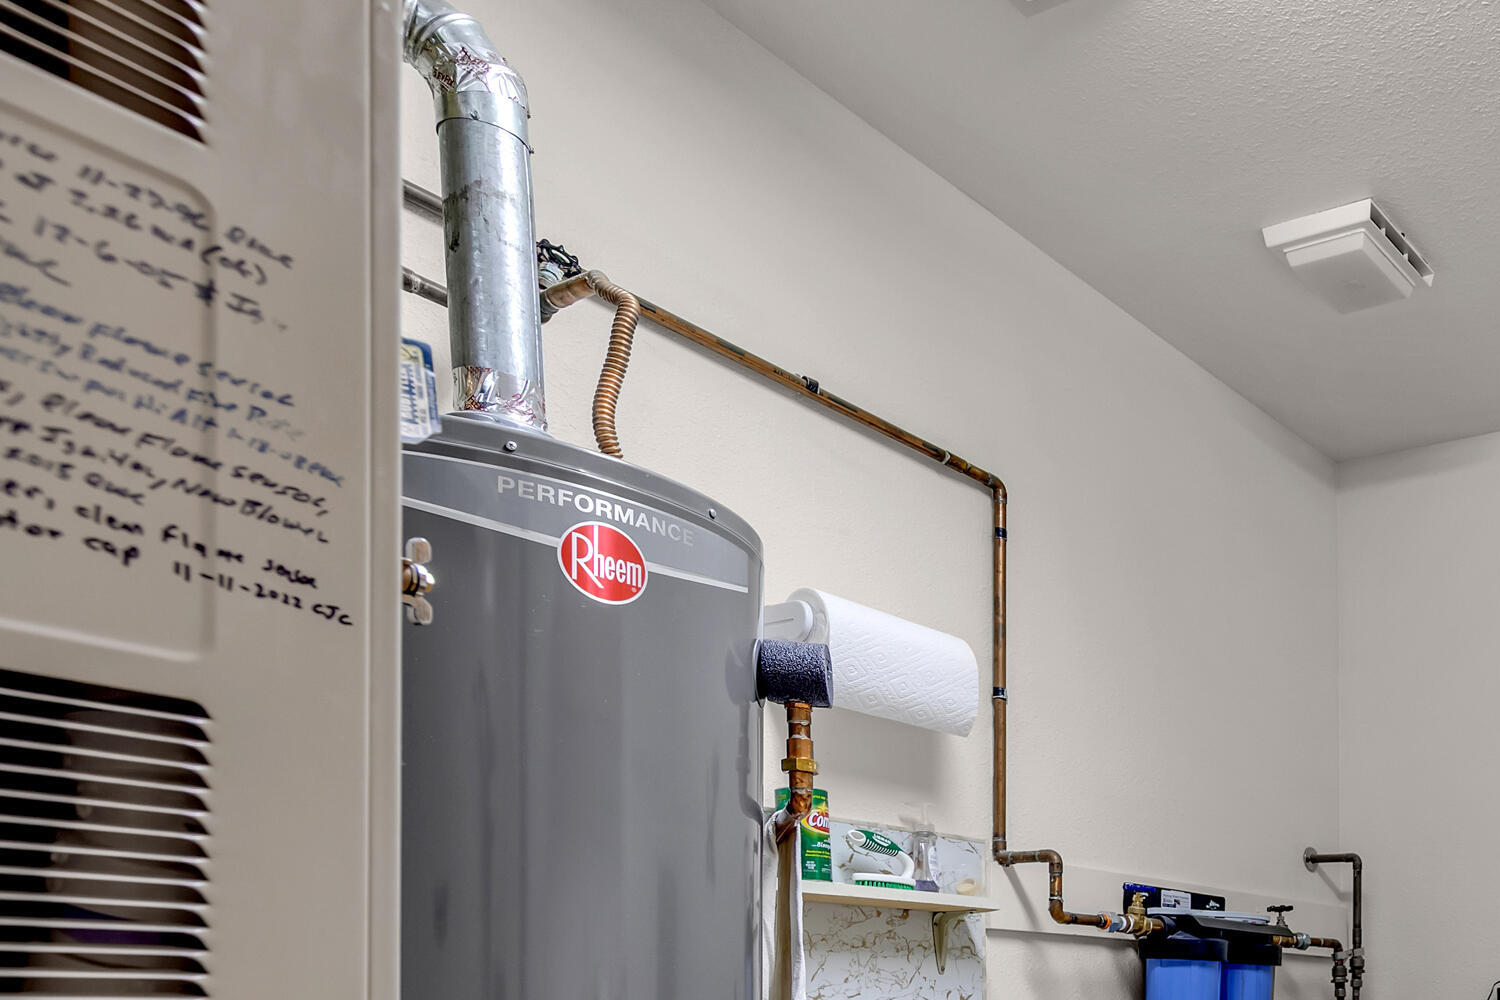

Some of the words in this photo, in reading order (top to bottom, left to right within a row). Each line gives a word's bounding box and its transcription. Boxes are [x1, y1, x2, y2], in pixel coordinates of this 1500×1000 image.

[497, 475, 694, 547] PERFORMANCE
[83, 536, 141, 568] cap
[571, 525, 642, 589] Rheem
